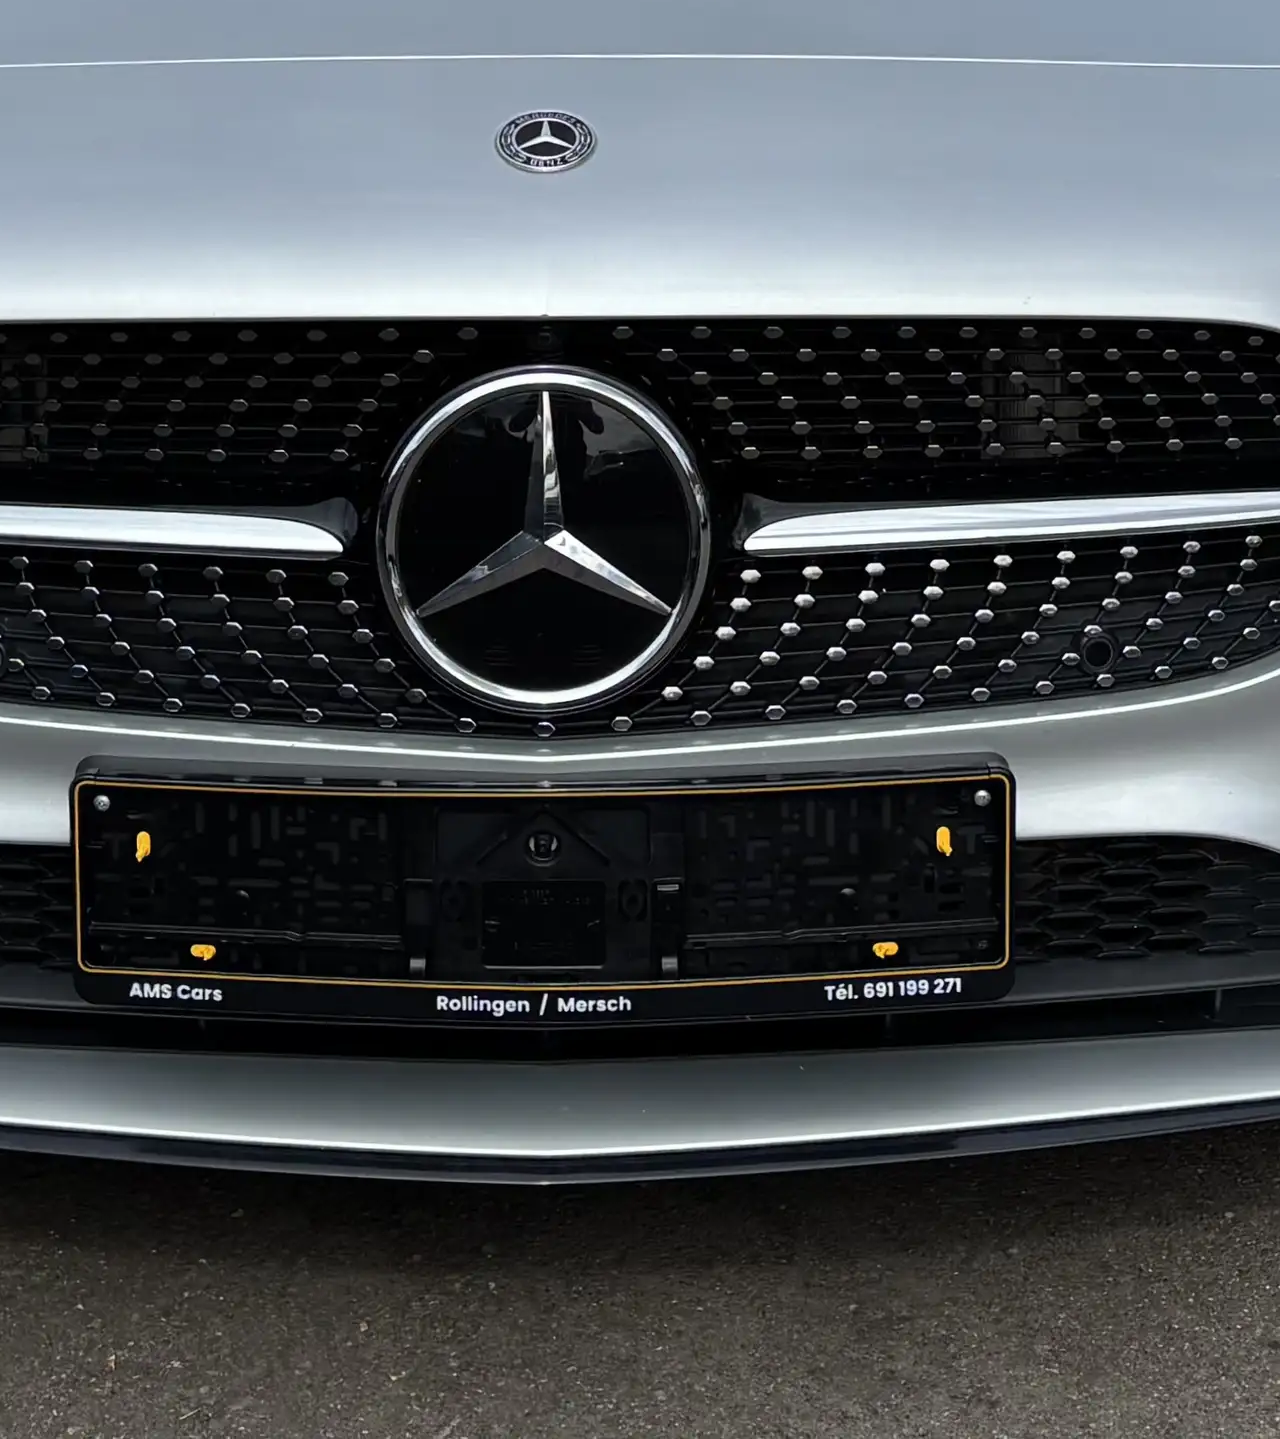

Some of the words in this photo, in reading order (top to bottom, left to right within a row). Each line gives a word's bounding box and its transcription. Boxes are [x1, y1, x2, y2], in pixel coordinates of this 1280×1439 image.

[129, 981, 172, 999] AMS
[176, 984, 223, 1001] Cars
[823, 983, 859, 1001] Tél.
[863, 981, 894, 999] 691
[898, 979, 930, 996] 199
[933, 977, 962, 994] 271
[436, 994, 531, 1017] Rollingen
[557, 996, 632, 1013] Mersch
